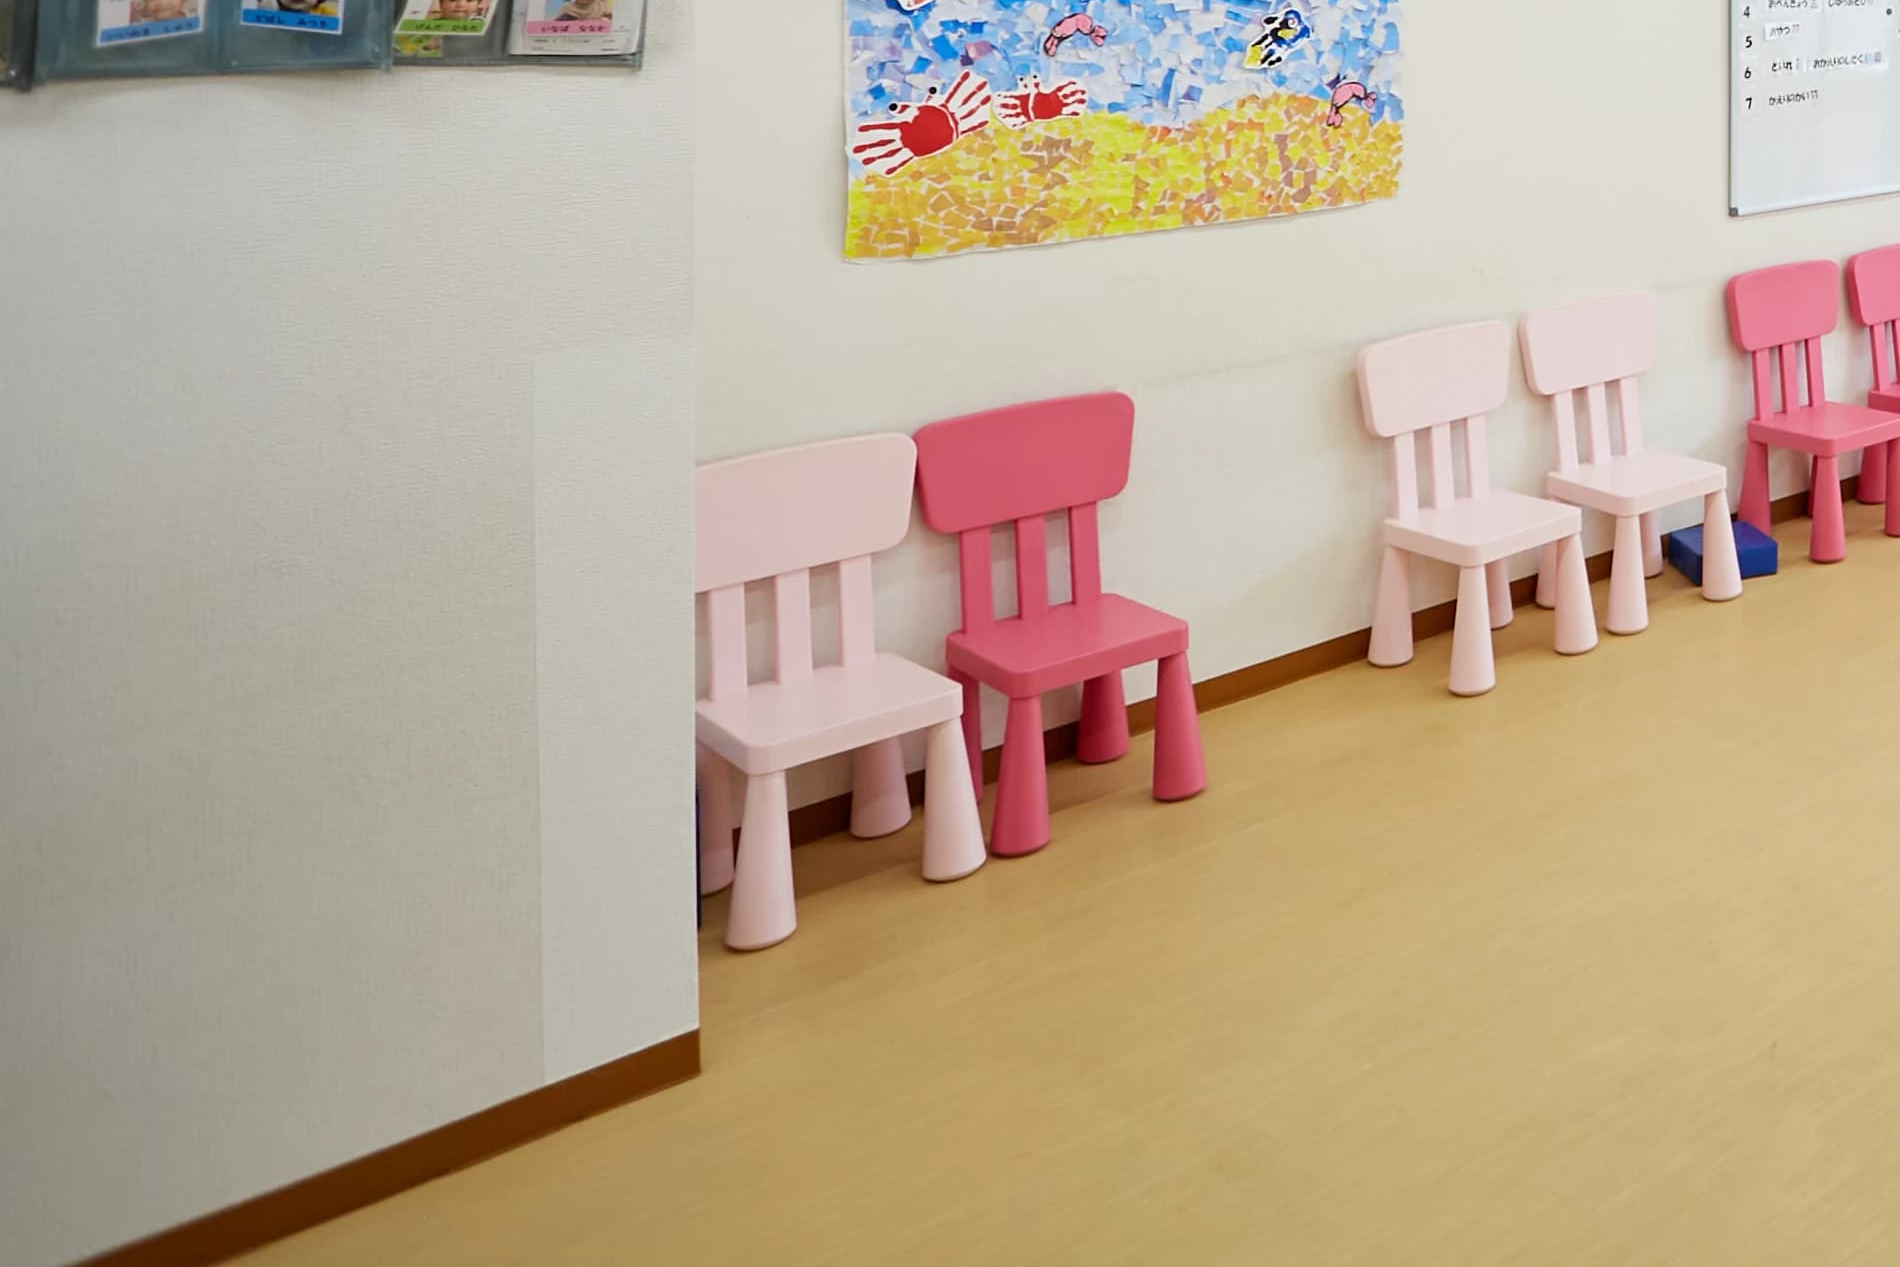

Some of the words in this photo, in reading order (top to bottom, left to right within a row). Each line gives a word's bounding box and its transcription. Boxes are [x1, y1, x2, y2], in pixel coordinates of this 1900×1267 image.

[1743, 6, 1750, 18] 4
[1745, 36, 1752, 48] 5
[1744, 66, 1751, 79] 6
[1745, 97, 1752, 110] 7
